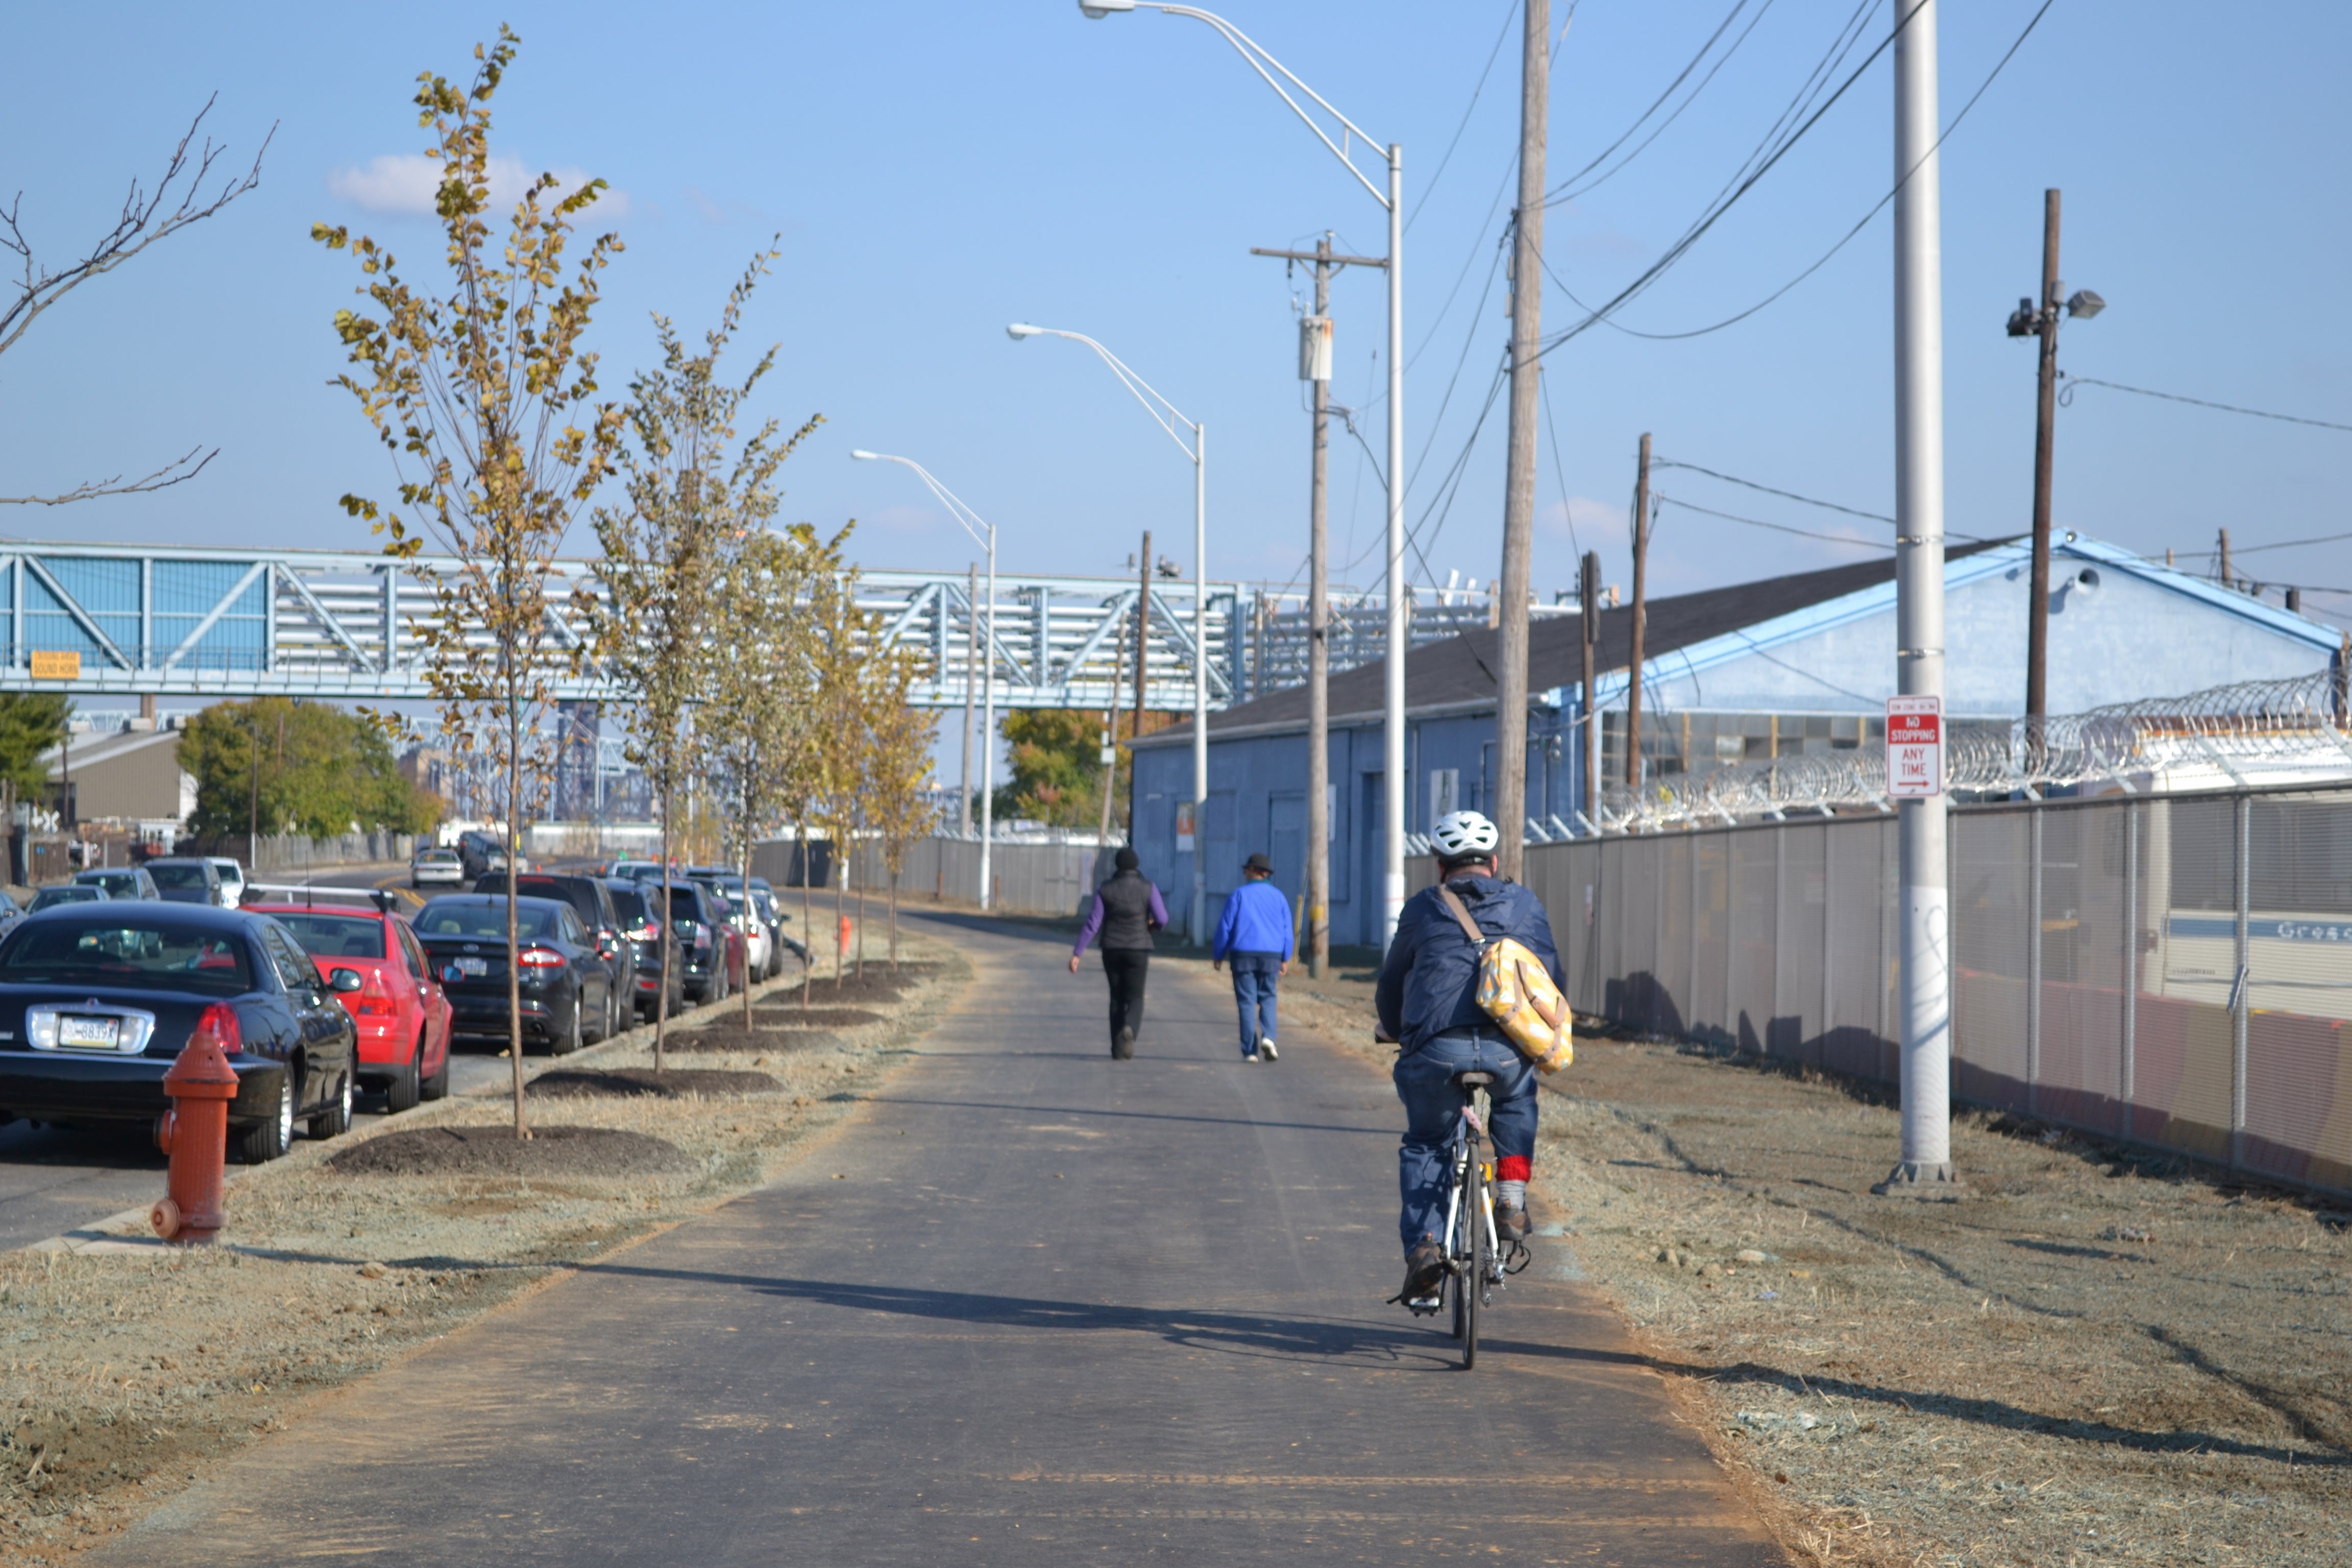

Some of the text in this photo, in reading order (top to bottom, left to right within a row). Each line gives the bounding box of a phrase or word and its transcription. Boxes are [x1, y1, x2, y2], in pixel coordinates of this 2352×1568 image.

[35, 664, 78, 674] SOUND HORN
[1906, 717, 1920, 728] NO
[1892, 729, 1935, 742] STOPPING
[1903, 748, 1925, 760] ANY
[1902, 763, 1926, 775] TIME
